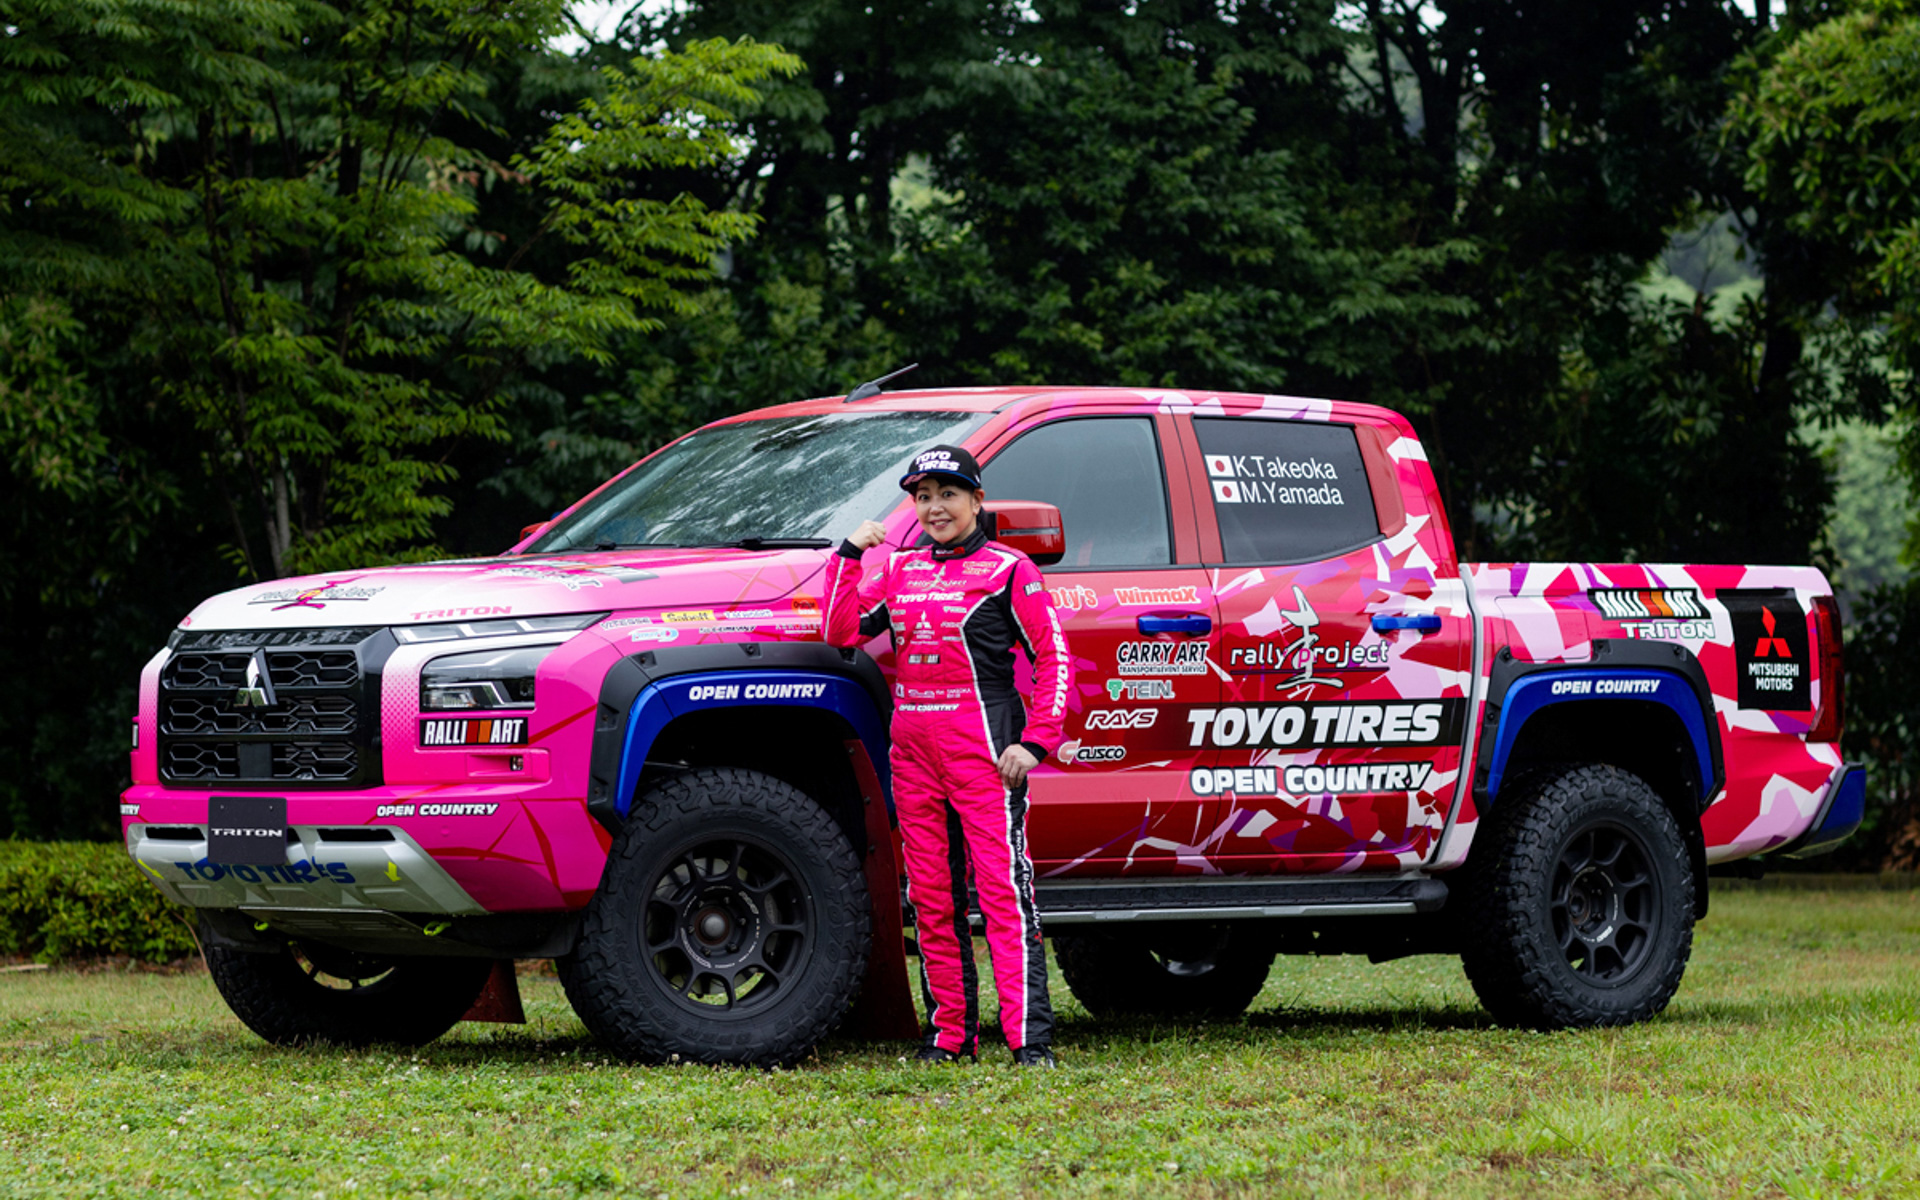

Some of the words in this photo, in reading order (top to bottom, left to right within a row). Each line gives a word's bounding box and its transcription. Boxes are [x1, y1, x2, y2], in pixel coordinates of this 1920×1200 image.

[916, 451, 952, 464] TOYO
[919, 460, 961, 471] TIRES
[1233, 455, 1338, 479] K.Takeoka
[1240, 481, 1344, 504] M.Yamada
[896, 594, 927, 603] TOYO
[928, 592, 965, 601] TIRES
[410, 606, 512, 620] TRITON
[1620, 622, 1716, 639] TRITON
[1118, 642, 1174, 663] CARRY
[1176, 642, 1209, 662] ART
[1231, 643, 1287, 668] rally
[1300, 640, 1389, 668] project
[1748, 662, 1799, 677] MITSUBISHI
[689, 684, 738, 700] OPEN
[744, 683, 826, 699] COUNTRY
[1052, 664, 1069, 716] TOYO
[1551, 680, 1591, 695] OPEN
[1595, 679, 1660, 694] COUNTRY
[1756, 677, 1793, 691] MOTORS
[1086, 709, 1158, 729] RAYS
[1187, 706, 1306, 746] TOYO
[1311, 704, 1443, 743] TIRES
[1077, 745, 1126, 760] CUSCO
[1191, 768, 1276, 794] OPEN
[1285, 763, 1432, 792] COUNTRY
[376, 804, 415, 817] OPEN
[419, 803, 498, 816] COUNTRY
[211, 828, 283, 838] TRITON
[174, 856, 262, 883] TOYO
[255, 856, 356, 884] TIRES
